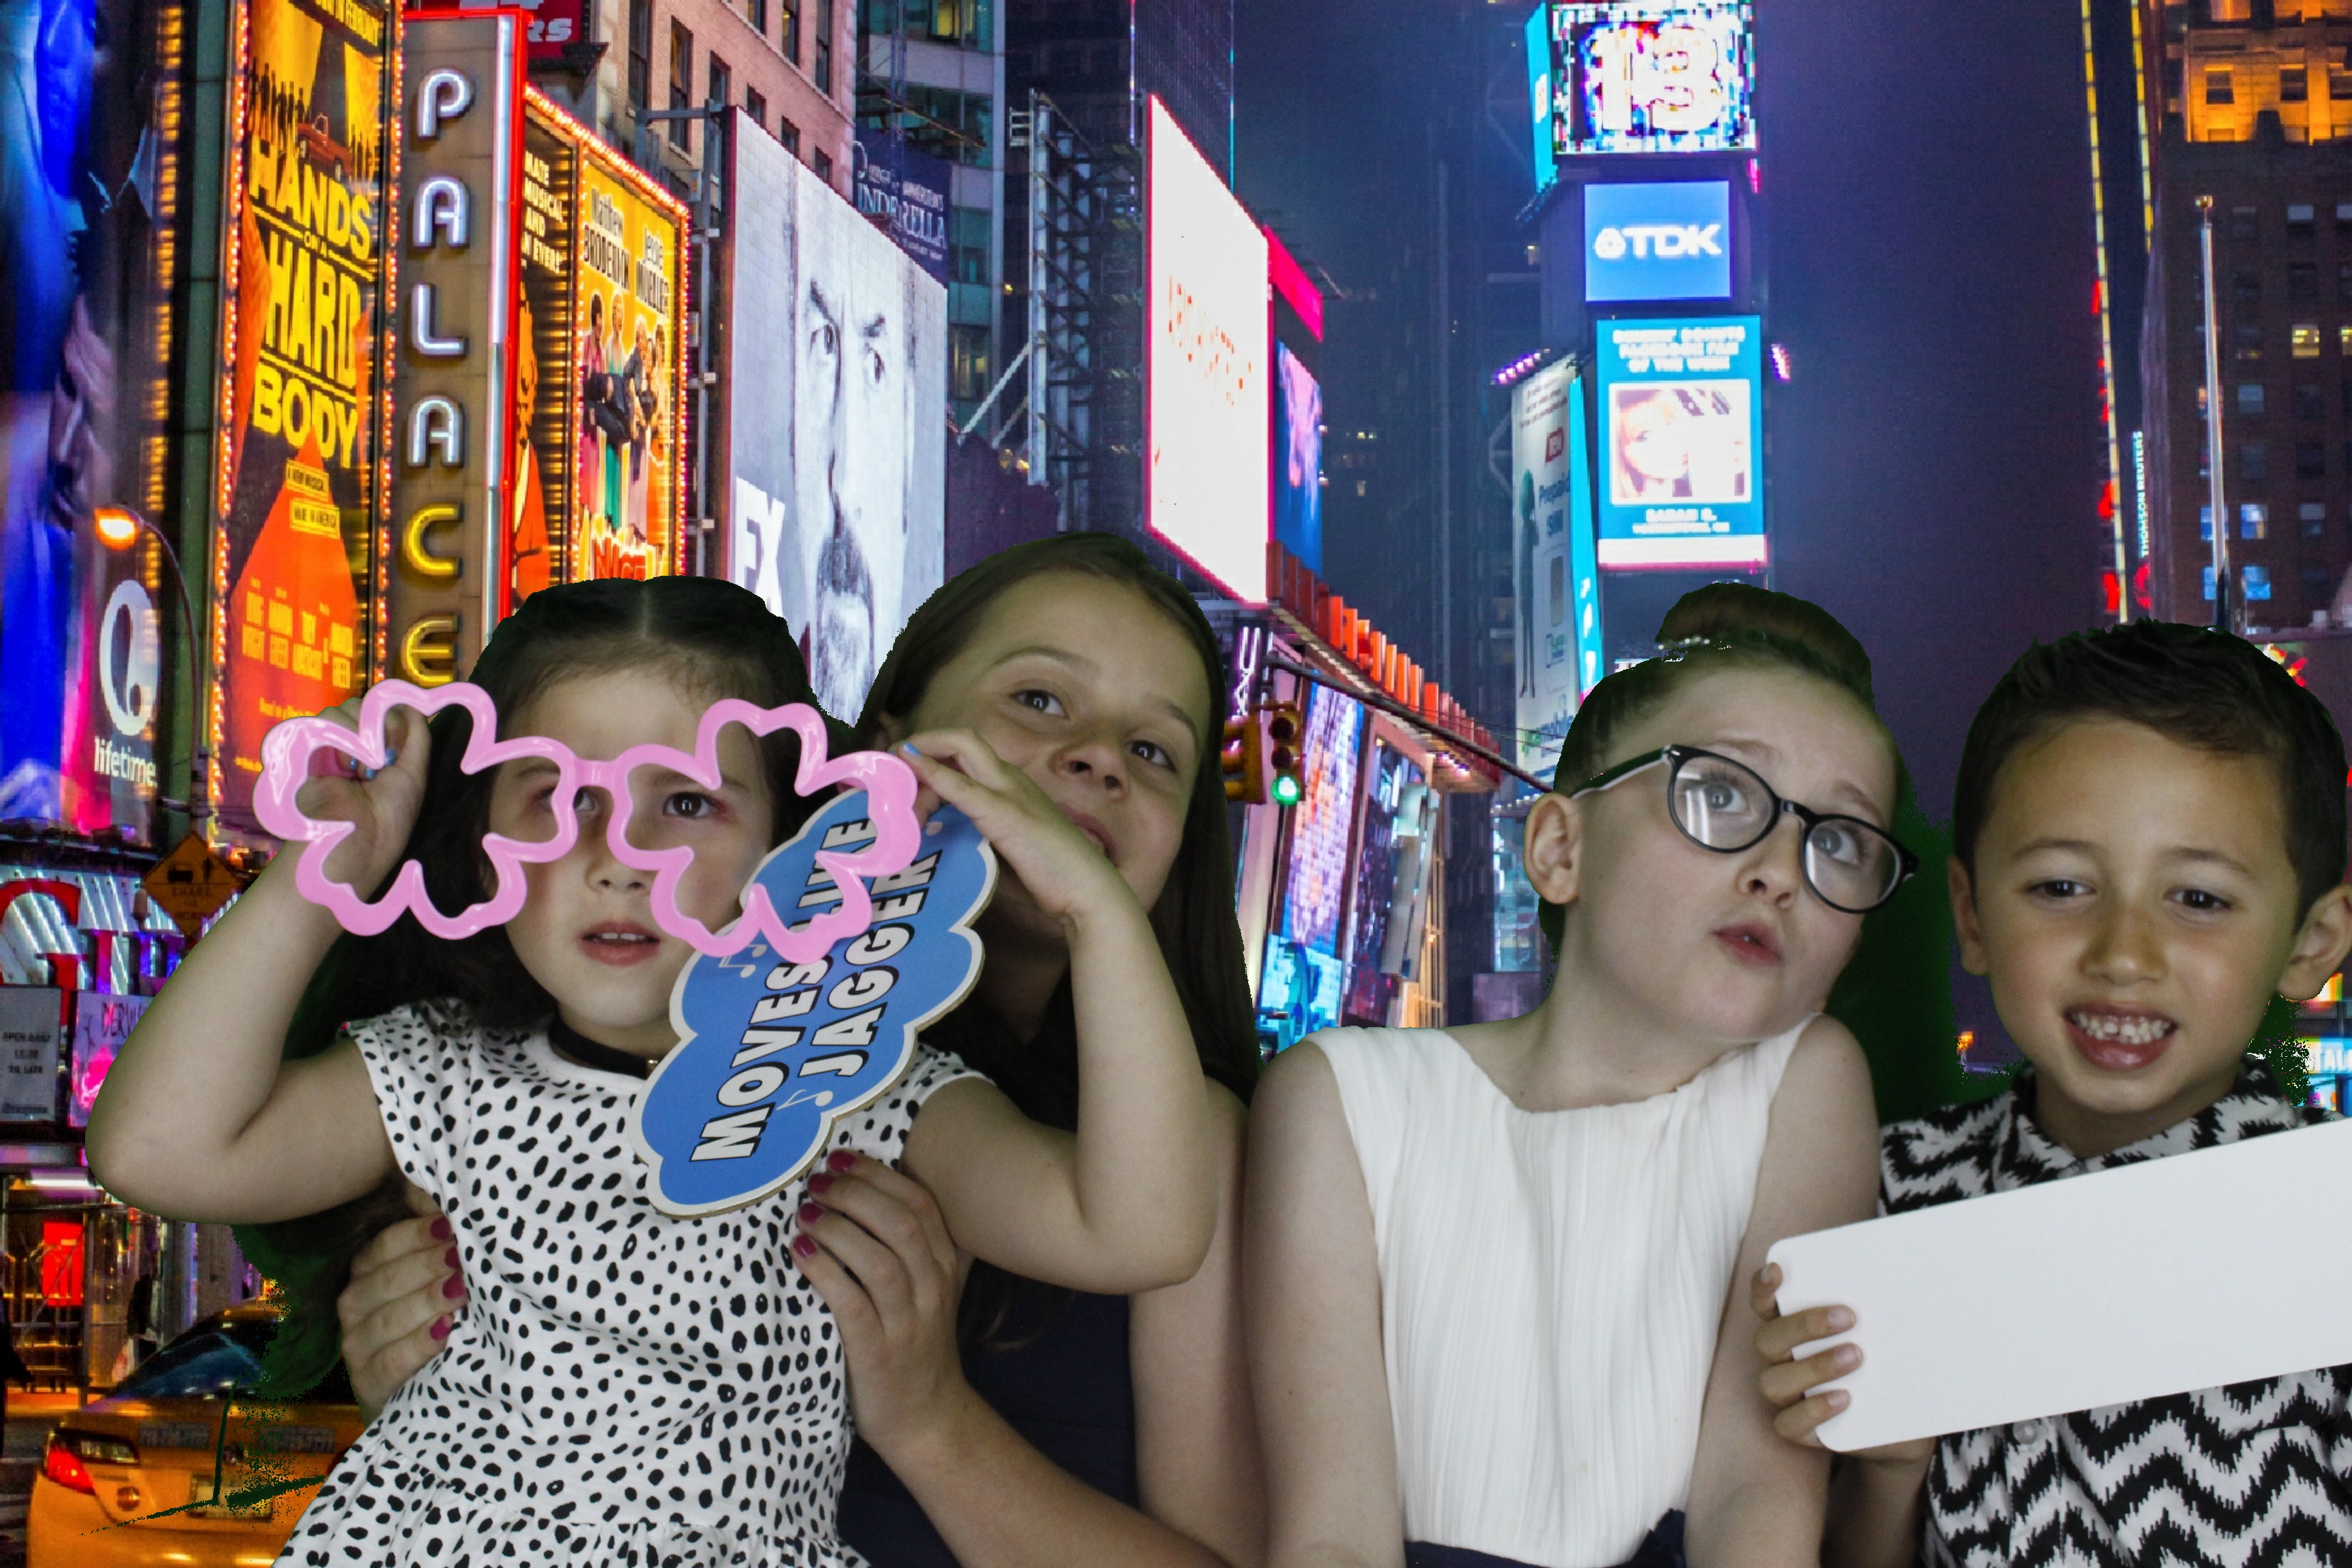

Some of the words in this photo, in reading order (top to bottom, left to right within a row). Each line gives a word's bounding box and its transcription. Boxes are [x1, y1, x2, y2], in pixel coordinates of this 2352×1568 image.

[249, 133, 371, 260] HANDS
[1622, 224, 1722, 258] TDK
[265, 230, 362, 389] HARD
[404, 69, 473, 683] PALACE
[252, 361, 359, 469] BODY
[736, 476, 785, 618] FX
[800, 849, 943, 1077] JAGGER
[689, 956, 834, 1162] MOVES
